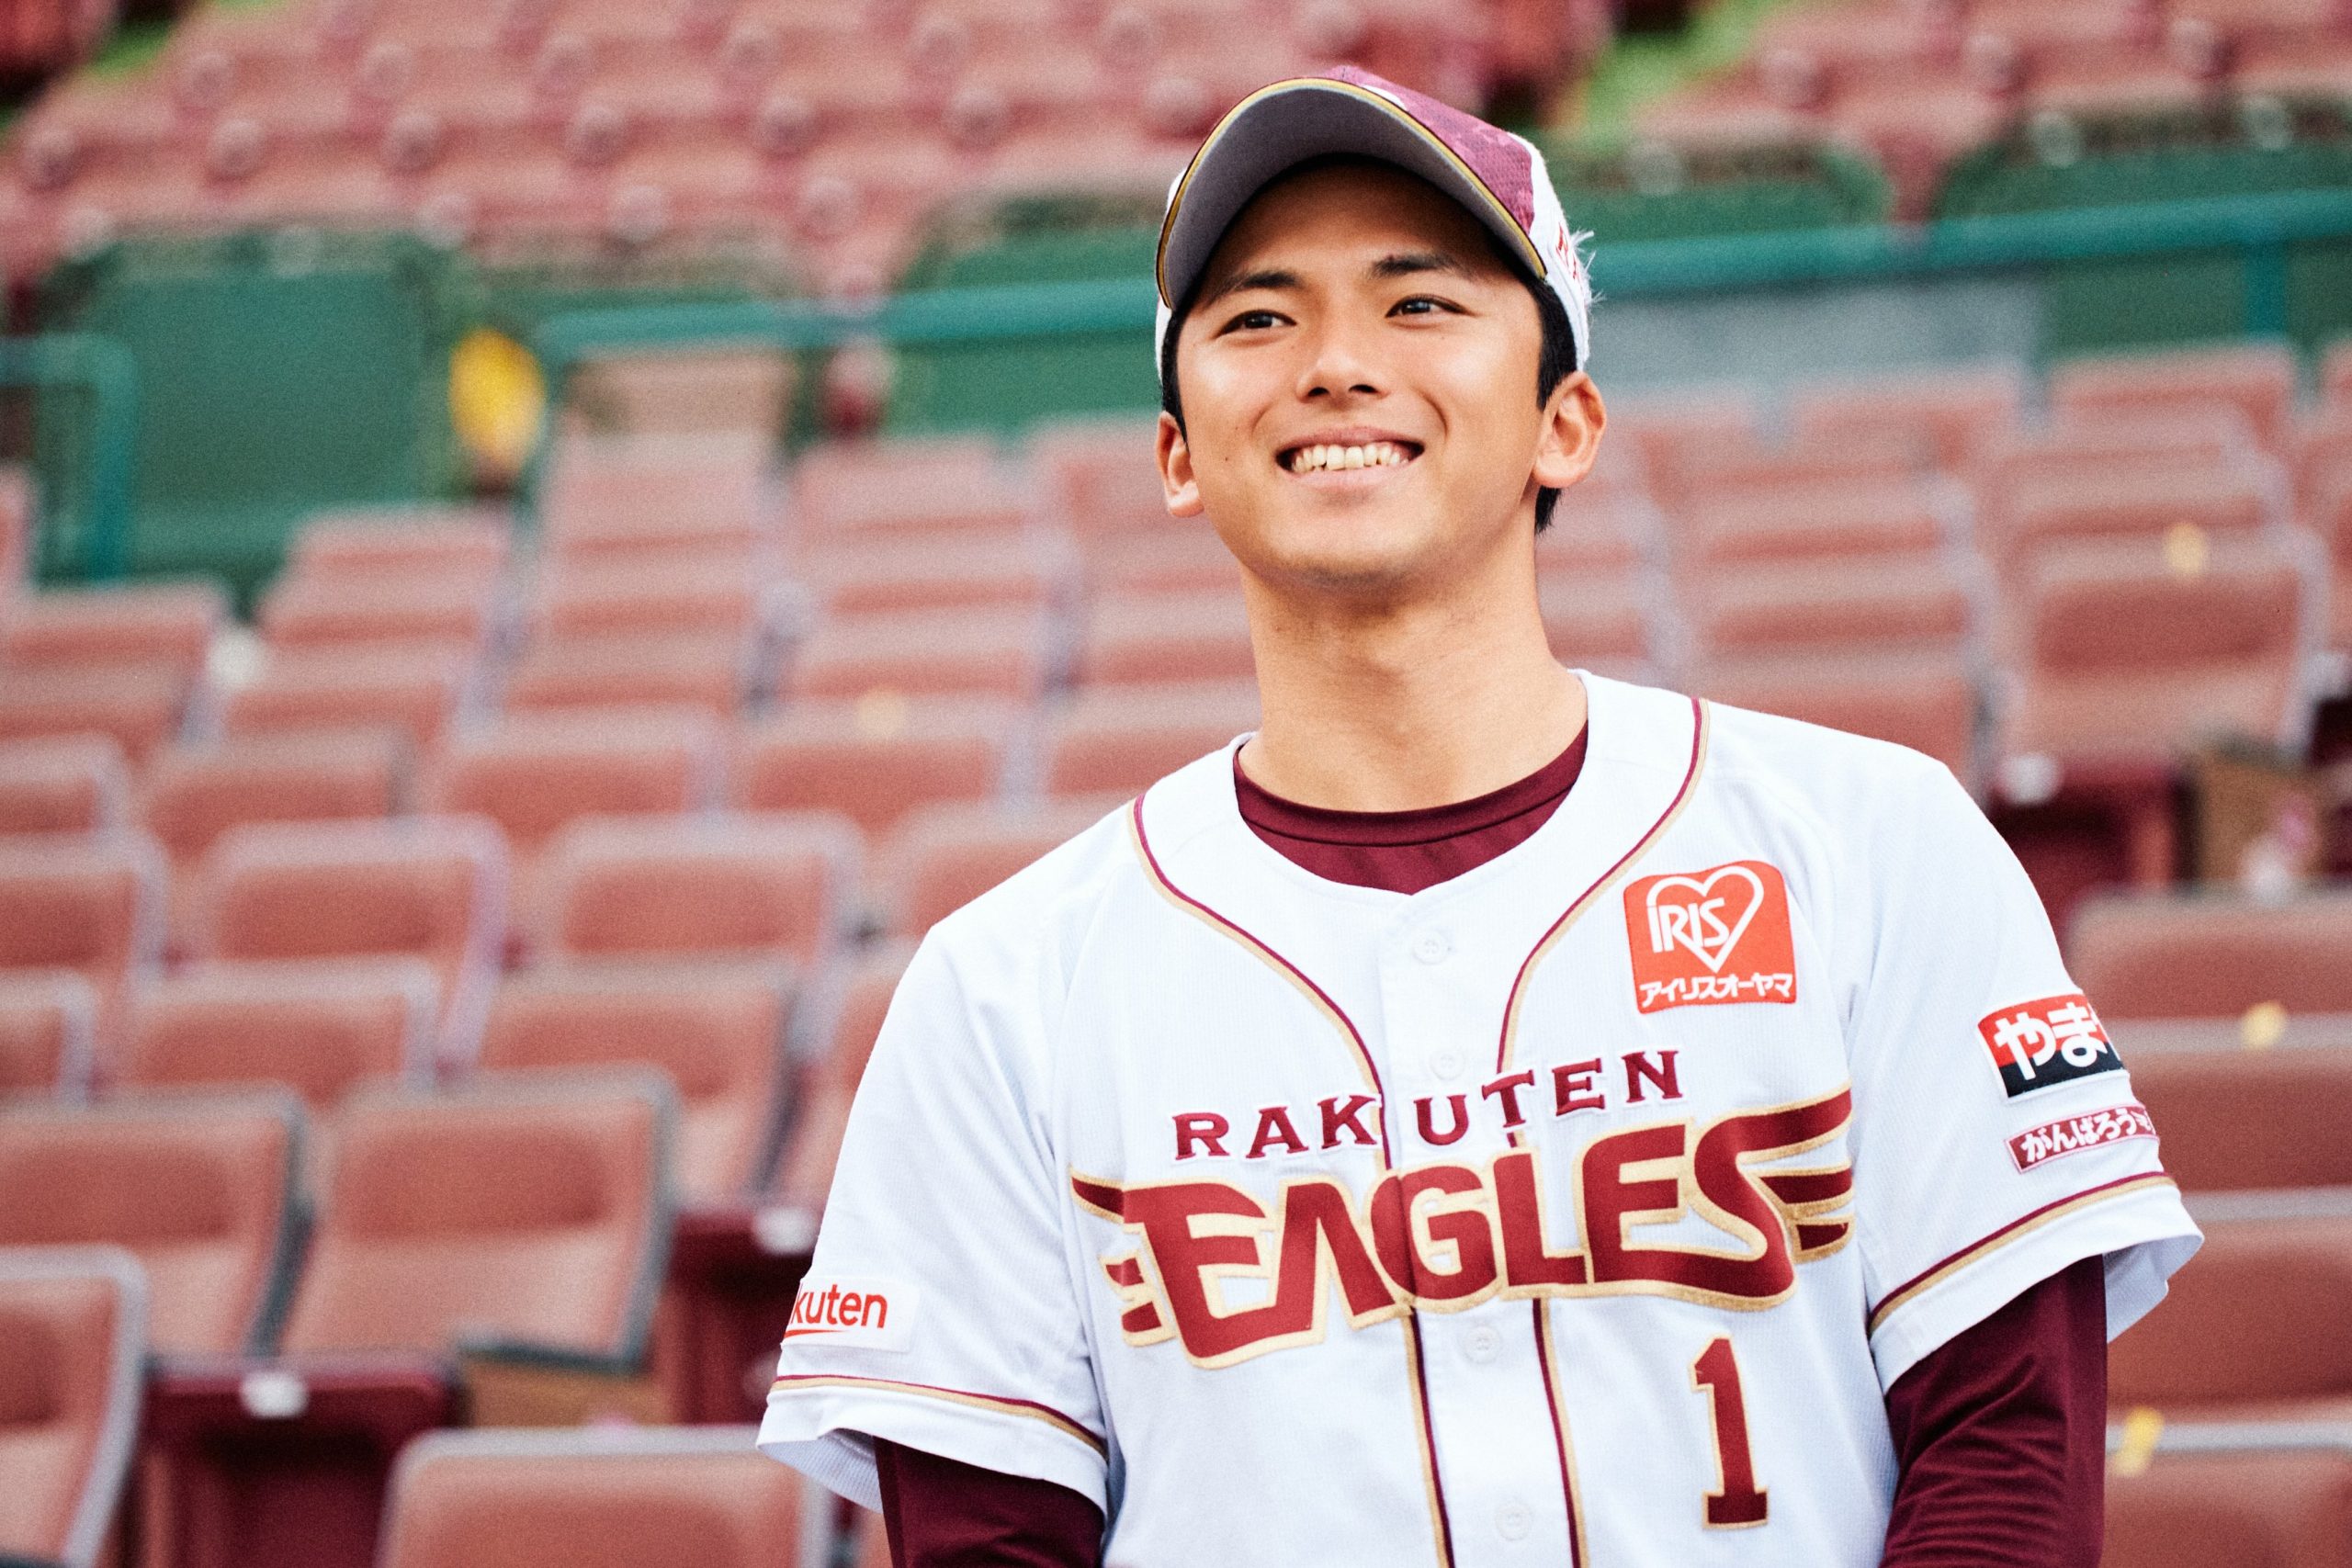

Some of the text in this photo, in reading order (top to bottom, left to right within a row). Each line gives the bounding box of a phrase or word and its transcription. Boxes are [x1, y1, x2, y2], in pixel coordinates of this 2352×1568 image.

[1646, 897, 1730, 953] IRIS
[1639, 972, 1792, 1008] アイリスオーヤマ
[1994, 1001, 2108, 1080] やま
[1172, 1049, 1683, 1160] RAKUTEN
[1071, 1086, 1851, 1367] EAGLES
[1692, 1336, 1768, 1529] 1
